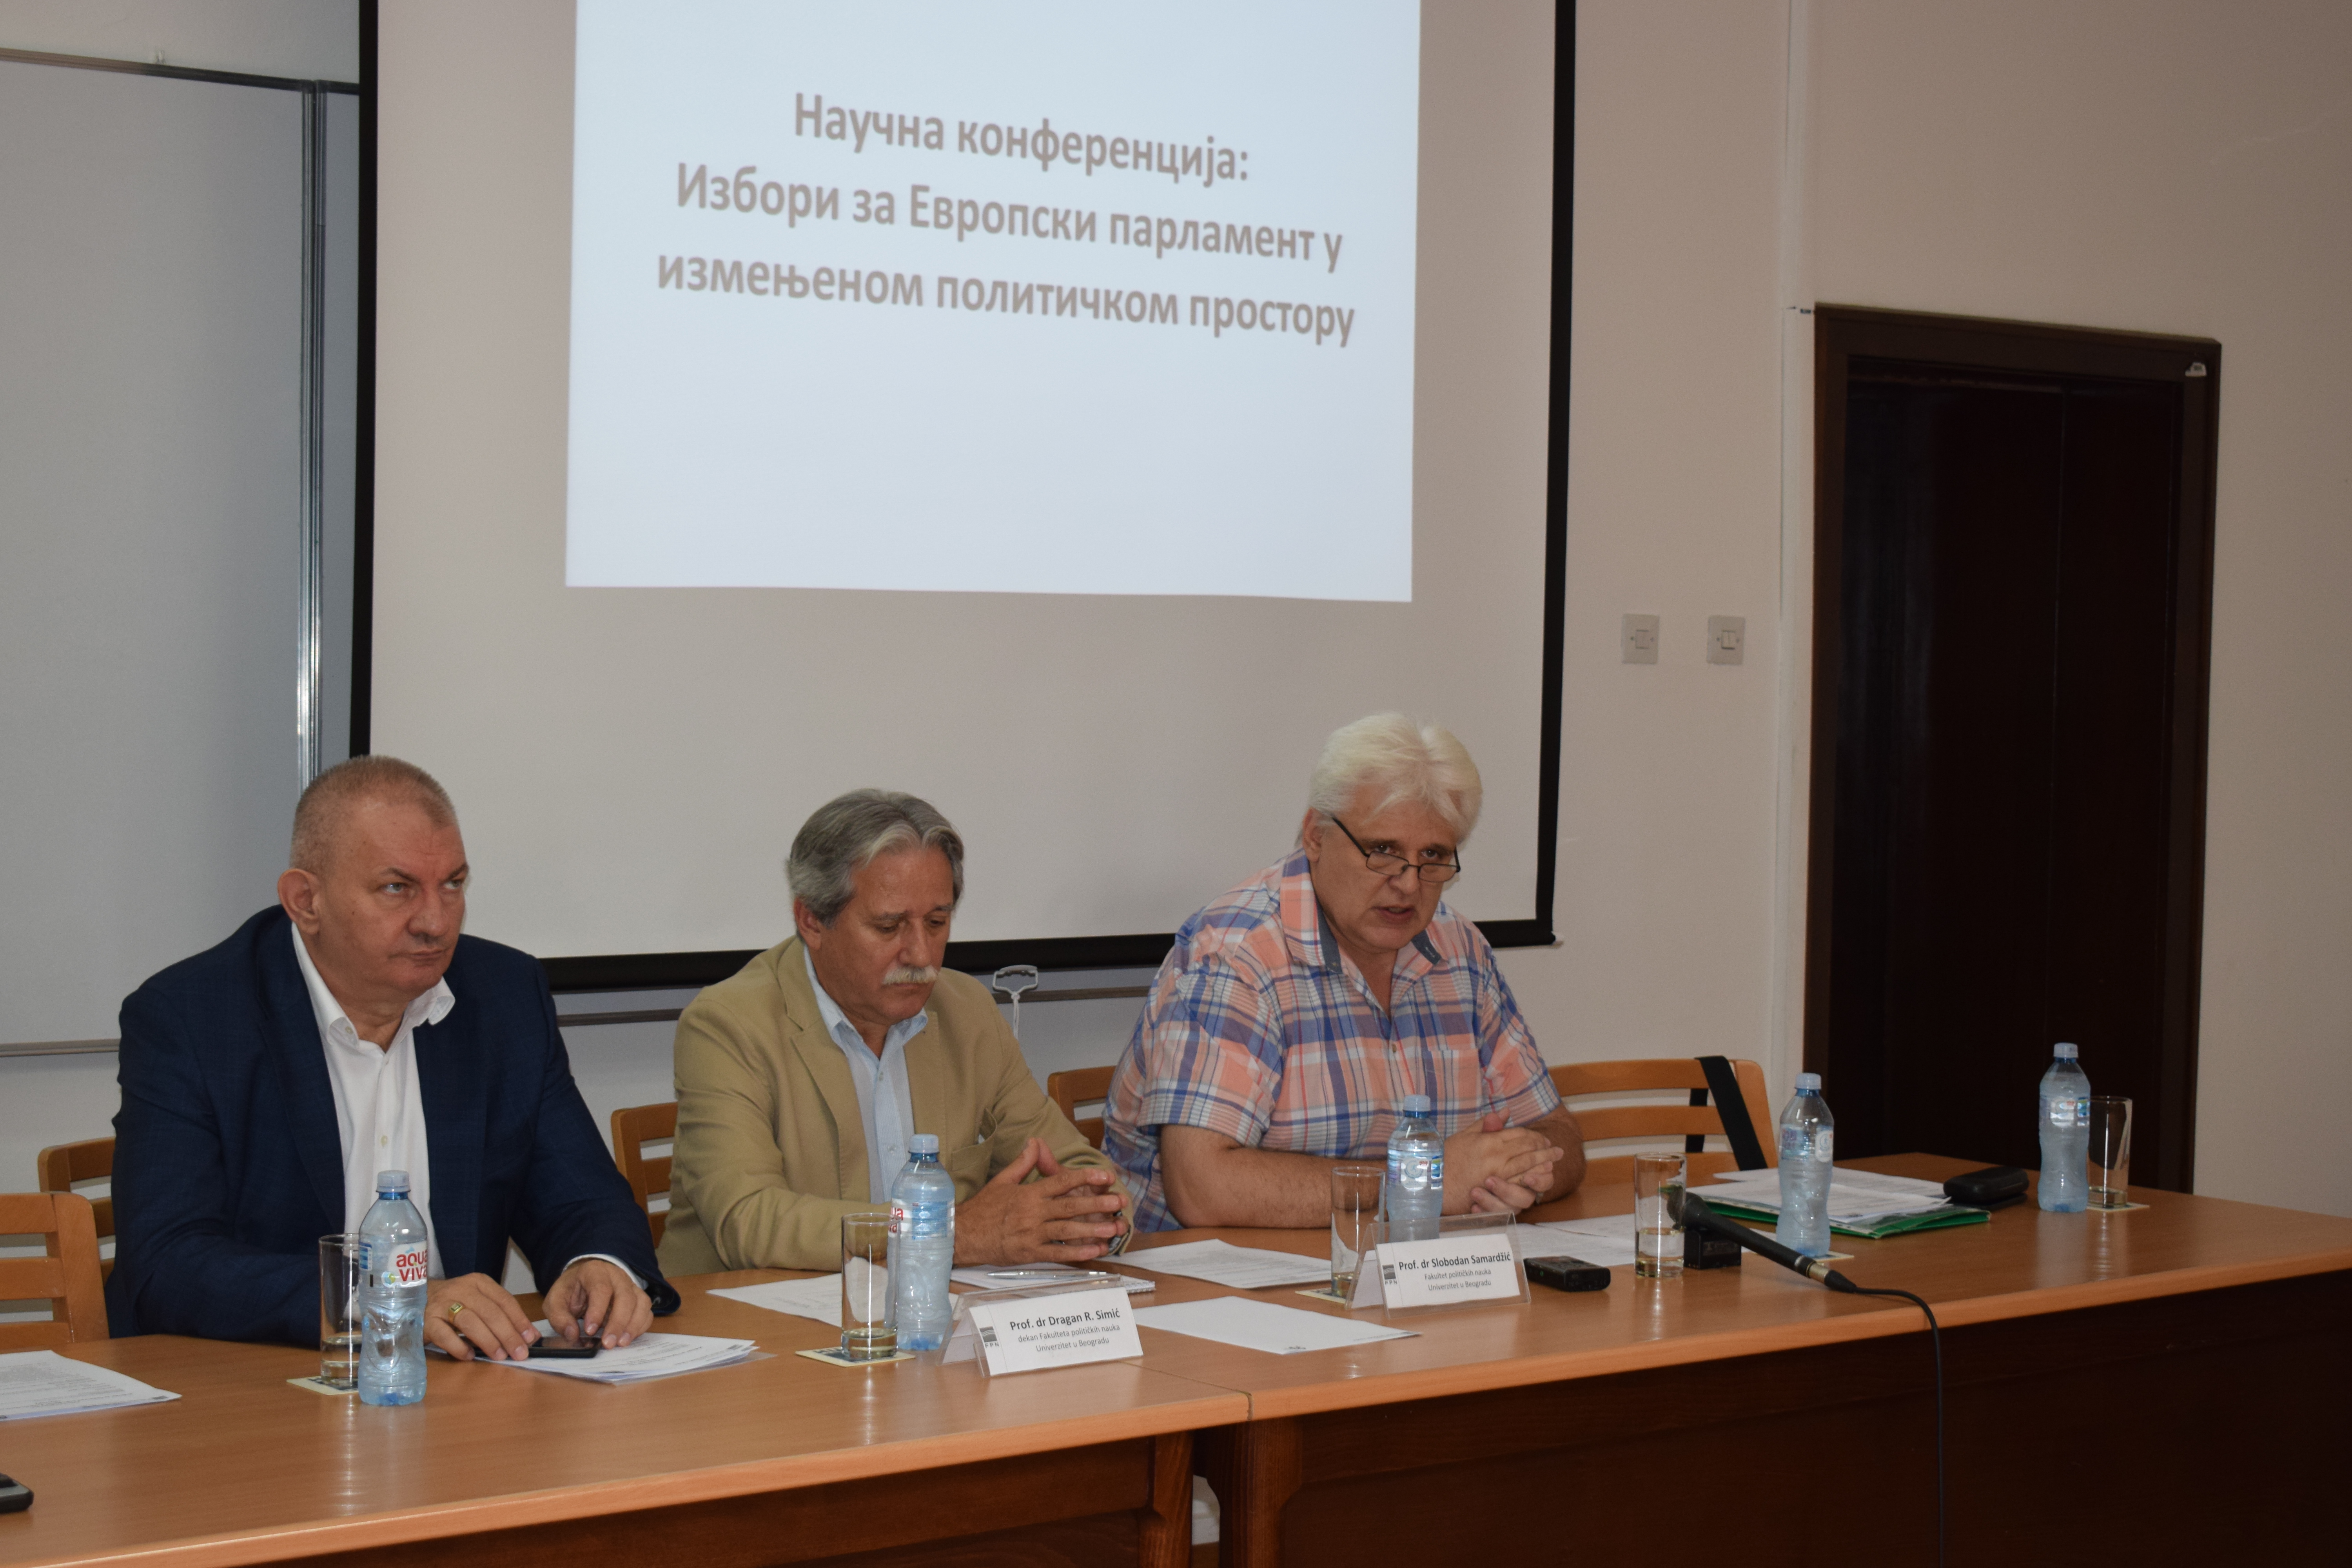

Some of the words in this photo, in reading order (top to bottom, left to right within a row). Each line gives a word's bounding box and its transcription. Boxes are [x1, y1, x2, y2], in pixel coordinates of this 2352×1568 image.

[795, 92, 945, 154] Научна
[957, 117, 1248, 189] конференција:
[677, 162, 840, 229] Избори
[852, 189, 896, 226] за
[909, 183, 1097, 243] Европски
[1109, 213, 1316, 261] парламент
[1323, 232, 1343, 274] у
[658, 254, 924, 307] измењеном
[936, 276, 1179, 325] политичком
[1189, 295, 1356, 348] простору
[1398, 1259, 1419, 1270] Prof.
[1421, 1259, 1430, 1269] dr
[1431, 1256, 1470, 1268] Slobodan
[1470, 1251, 1511, 1264] Samardžić
[1448, 1269, 1474, 1279] političkih
[1428, 1283, 1459, 1291] Univerzitet
[1465, 1279, 1491, 1288] Beogradu
[1009, 1318, 1034, 1330] Prof.
[1036, 1317, 1046, 1327] dr
[1048, 1315, 1083, 1326] Dragan
[1084, 1312, 1094, 1321] R.
[1096, 1308, 1120, 1320] Simić
[1018, 1334, 1038, 1343] dekan
[1039, 1330, 1070, 1340] Fakulteta
[1071, 1326, 1100, 1337] političkih
[1101, 1324, 1120, 1332] nauka
[1036, 1342, 1072, 1352] Univerzitet
[1078, 1337, 1109, 1347] Beogradu
